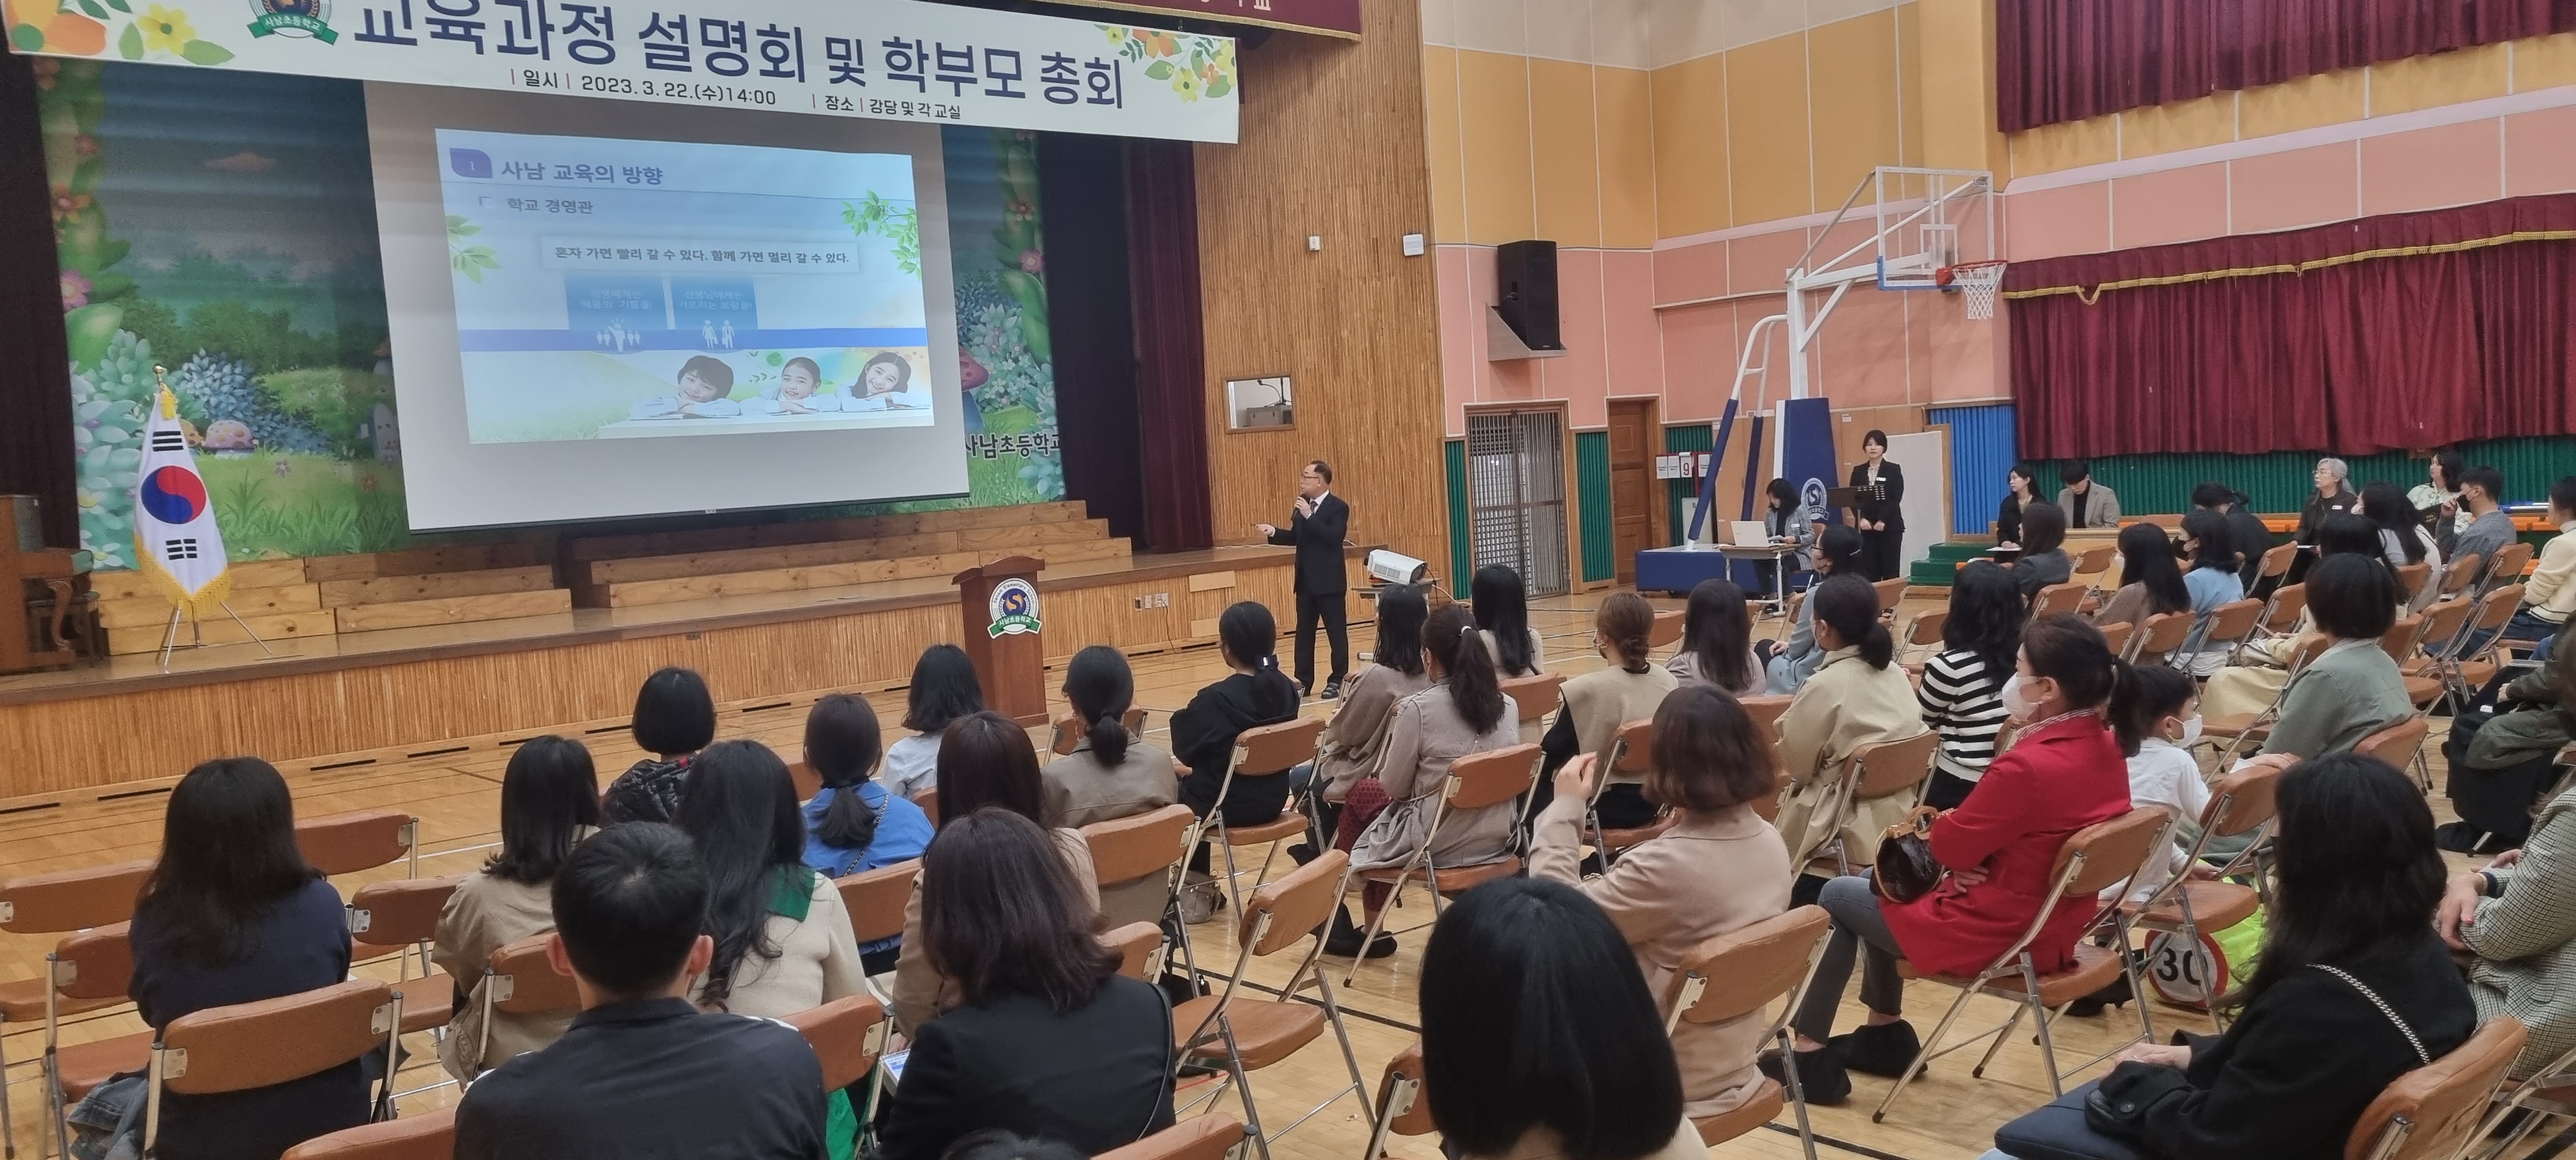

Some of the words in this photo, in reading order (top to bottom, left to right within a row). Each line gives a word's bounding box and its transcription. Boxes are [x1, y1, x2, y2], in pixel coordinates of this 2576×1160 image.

[264, 15, 320, 31] 사남초등학교
[354, 0, 616, 65] 교육과정
[638, 11, 806, 83] 설명회
[825, 36, 866, 88] 및
[882, 36, 1026, 99] 학부모
[1040, 51, 1123, 109] 총회
[523, 69, 558, 89] 일시
[824, 95, 854, 111] 장소
[869, 98, 897, 115] 강당
[901, 101, 914, 116] 및
[917, 103, 930, 118] 각
[934, 104, 962, 120] 교실
[501, 160, 546, 181] 사남
[553, 164, 615, 184] 교육의
[622, 166, 664, 186] 방향
[507, 197, 540, 213] 학교
[546, 199, 594, 215] 경영관
[555, 247, 582, 259] 혼자
[586, 247, 612, 259] 가면
[617, 248, 642, 261] 빨리
[647, 248, 659, 261] 갈
[663, 249, 676, 261] 수
[680, 249, 709, 261] 있다.
[711, 249, 736, 262] 함께
[740, 250, 764, 263] 가면
[768, 251, 792, 263] 멀리
[796, 252, 808, 264] 갈
[811, 252, 822, 264] 수
[825, 252, 849, 264] 있다.
[1683, 462, 1690, 476] 9
[2156, 947, 2209, 986] 30
